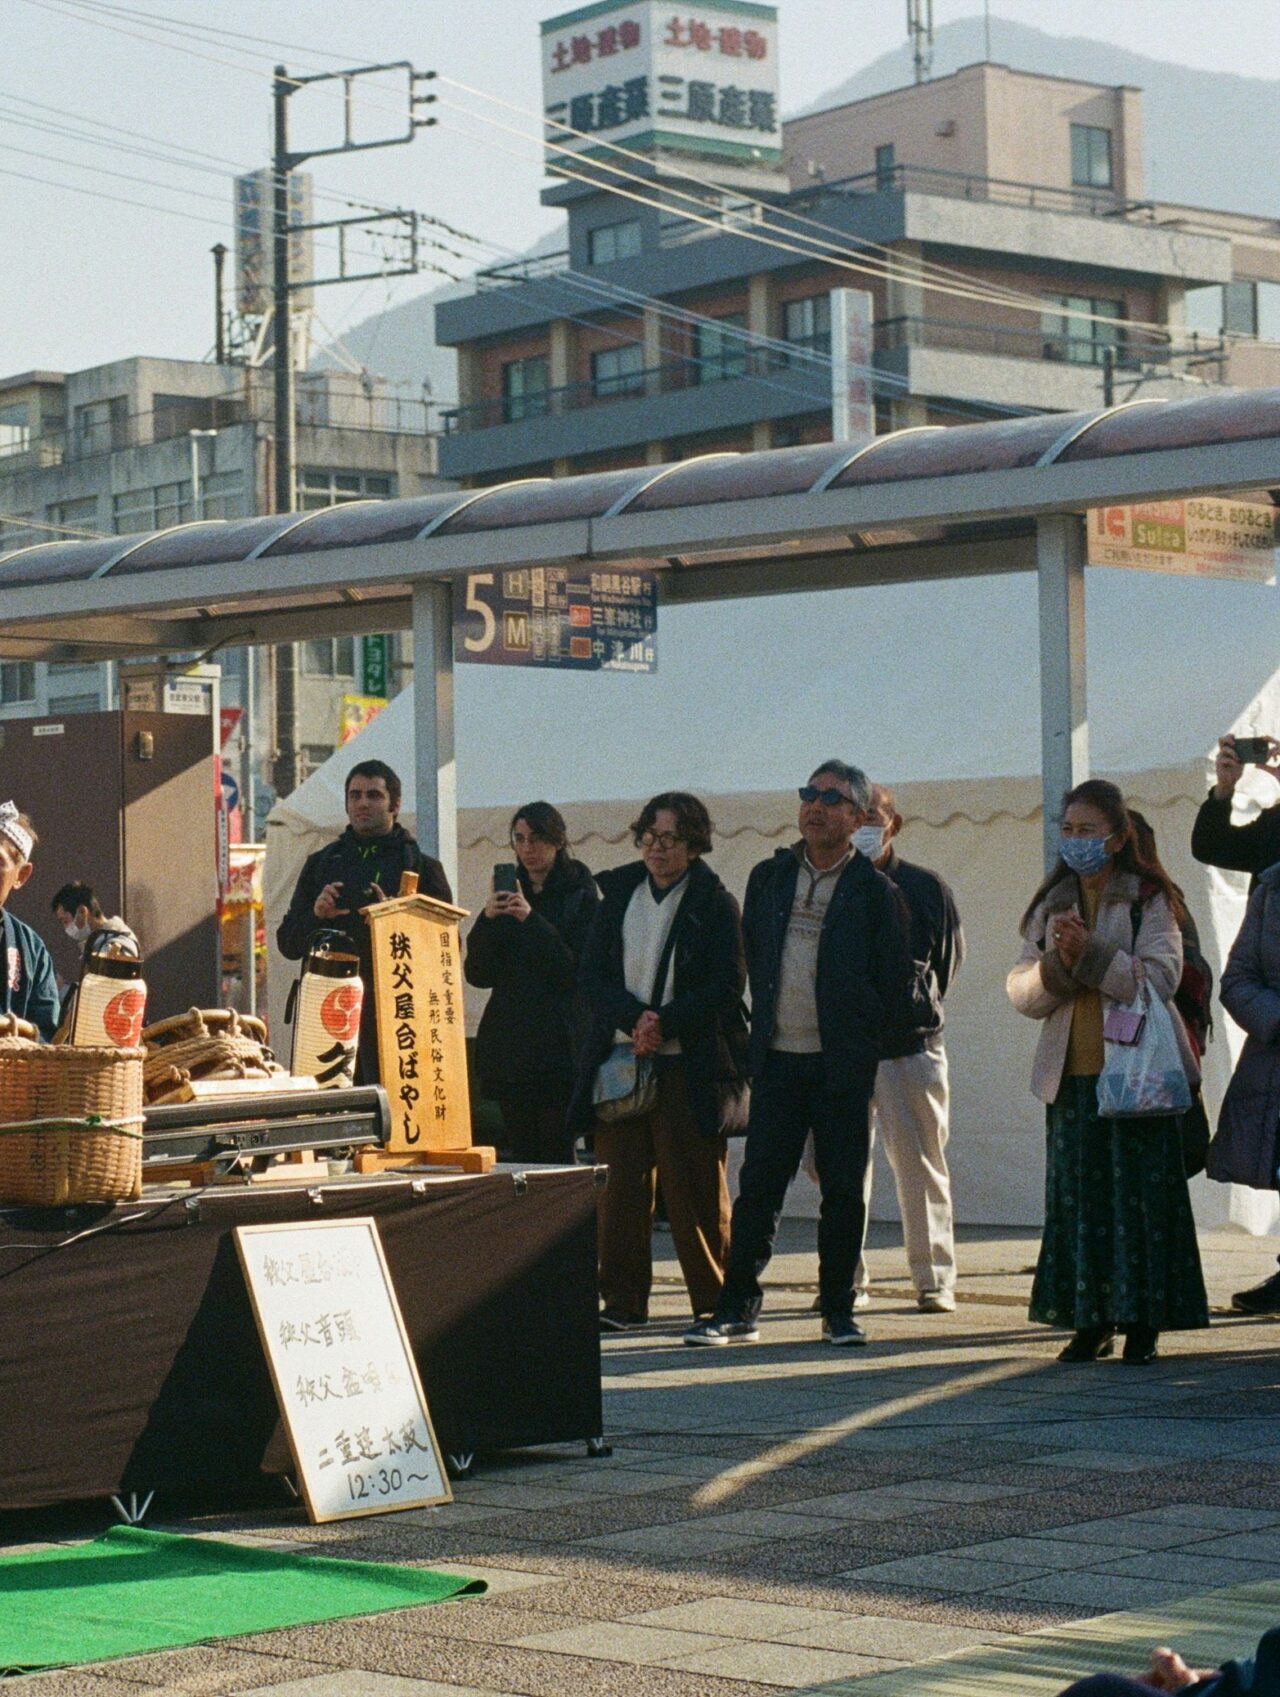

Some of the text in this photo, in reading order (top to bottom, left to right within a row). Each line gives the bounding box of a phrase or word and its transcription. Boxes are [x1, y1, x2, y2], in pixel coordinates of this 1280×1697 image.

[464, 573, 496, 652] 5
[509, 573, 524, 593] H
[507, 616, 526, 646] M
[439, 932, 456, 1024] 国指定重要
[389, 932, 421, 1145] 秩父屋台ばやし
[428, 990, 447, 1121] 無形民俗文化財
